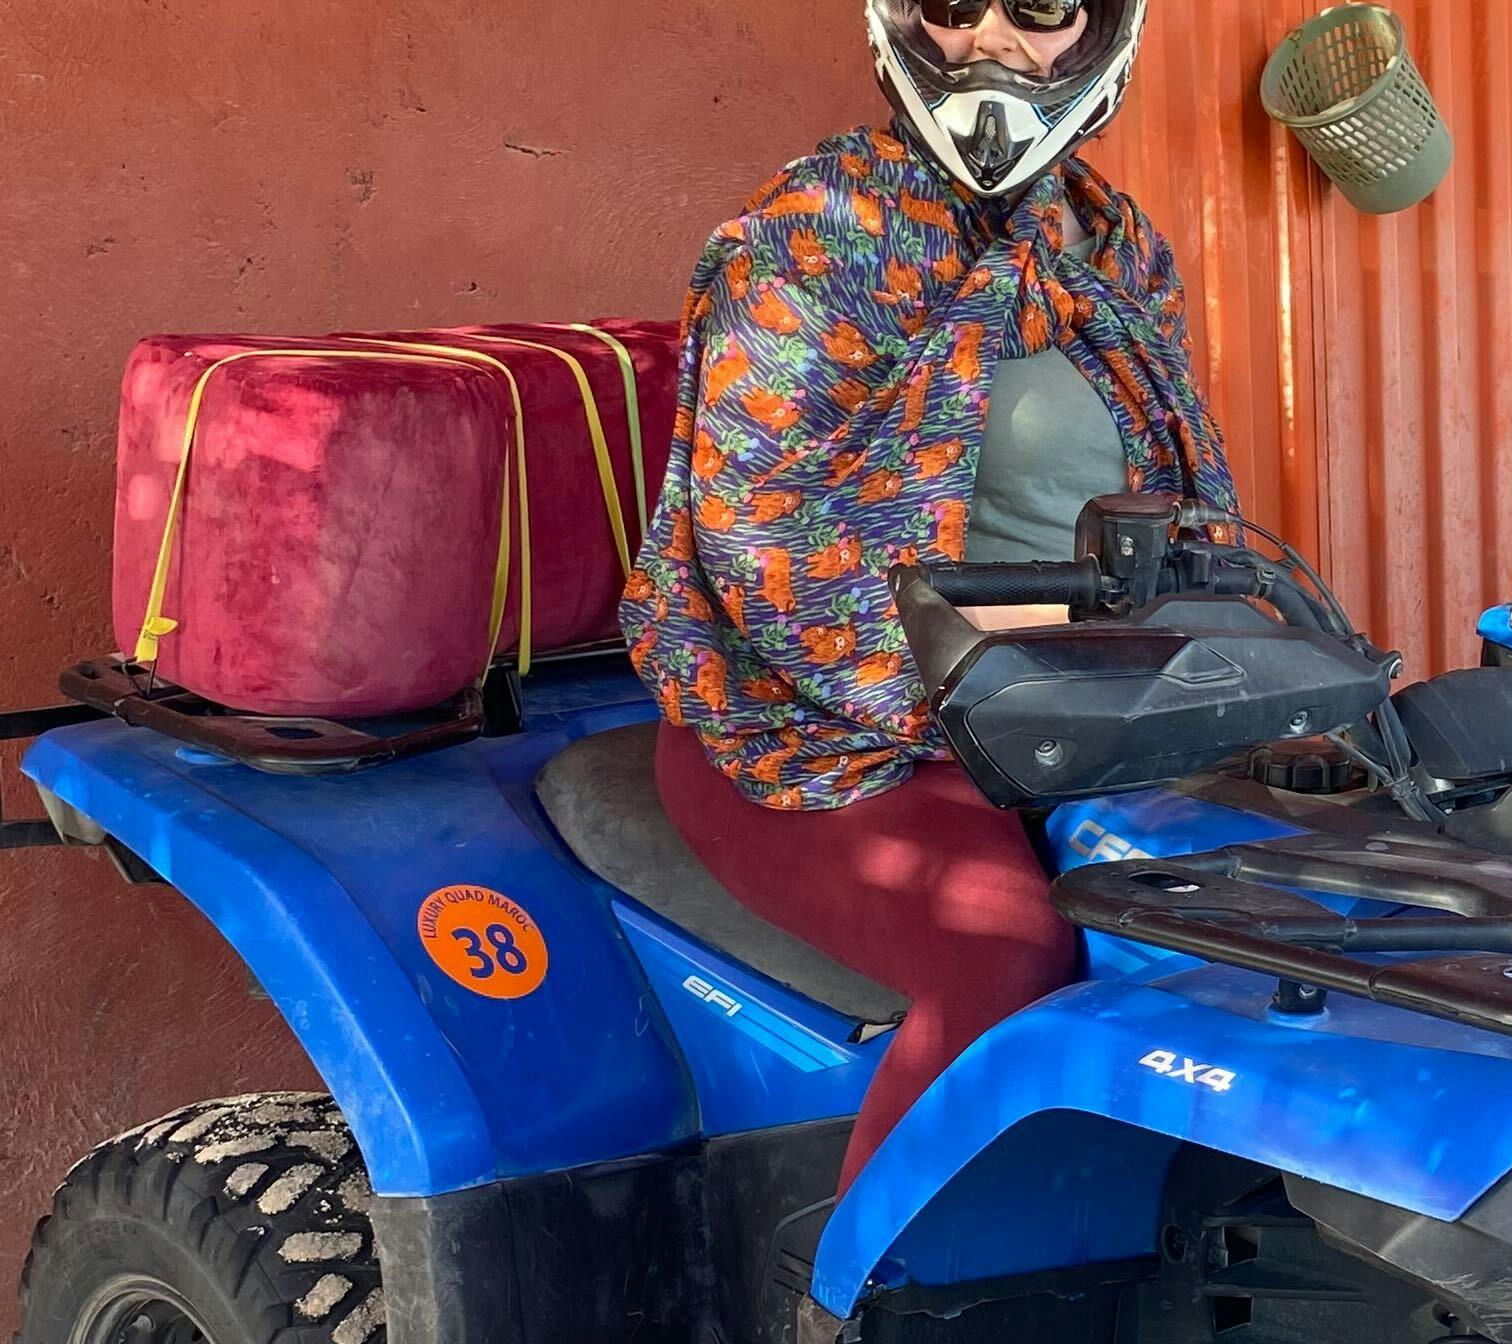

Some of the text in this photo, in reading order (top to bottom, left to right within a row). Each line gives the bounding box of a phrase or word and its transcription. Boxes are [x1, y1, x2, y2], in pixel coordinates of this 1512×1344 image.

[422, 889, 534, 939] LUXURY QUAD MAROC
[451, 923, 528, 979] 38
[682, 975, 743, 1017] EFI
